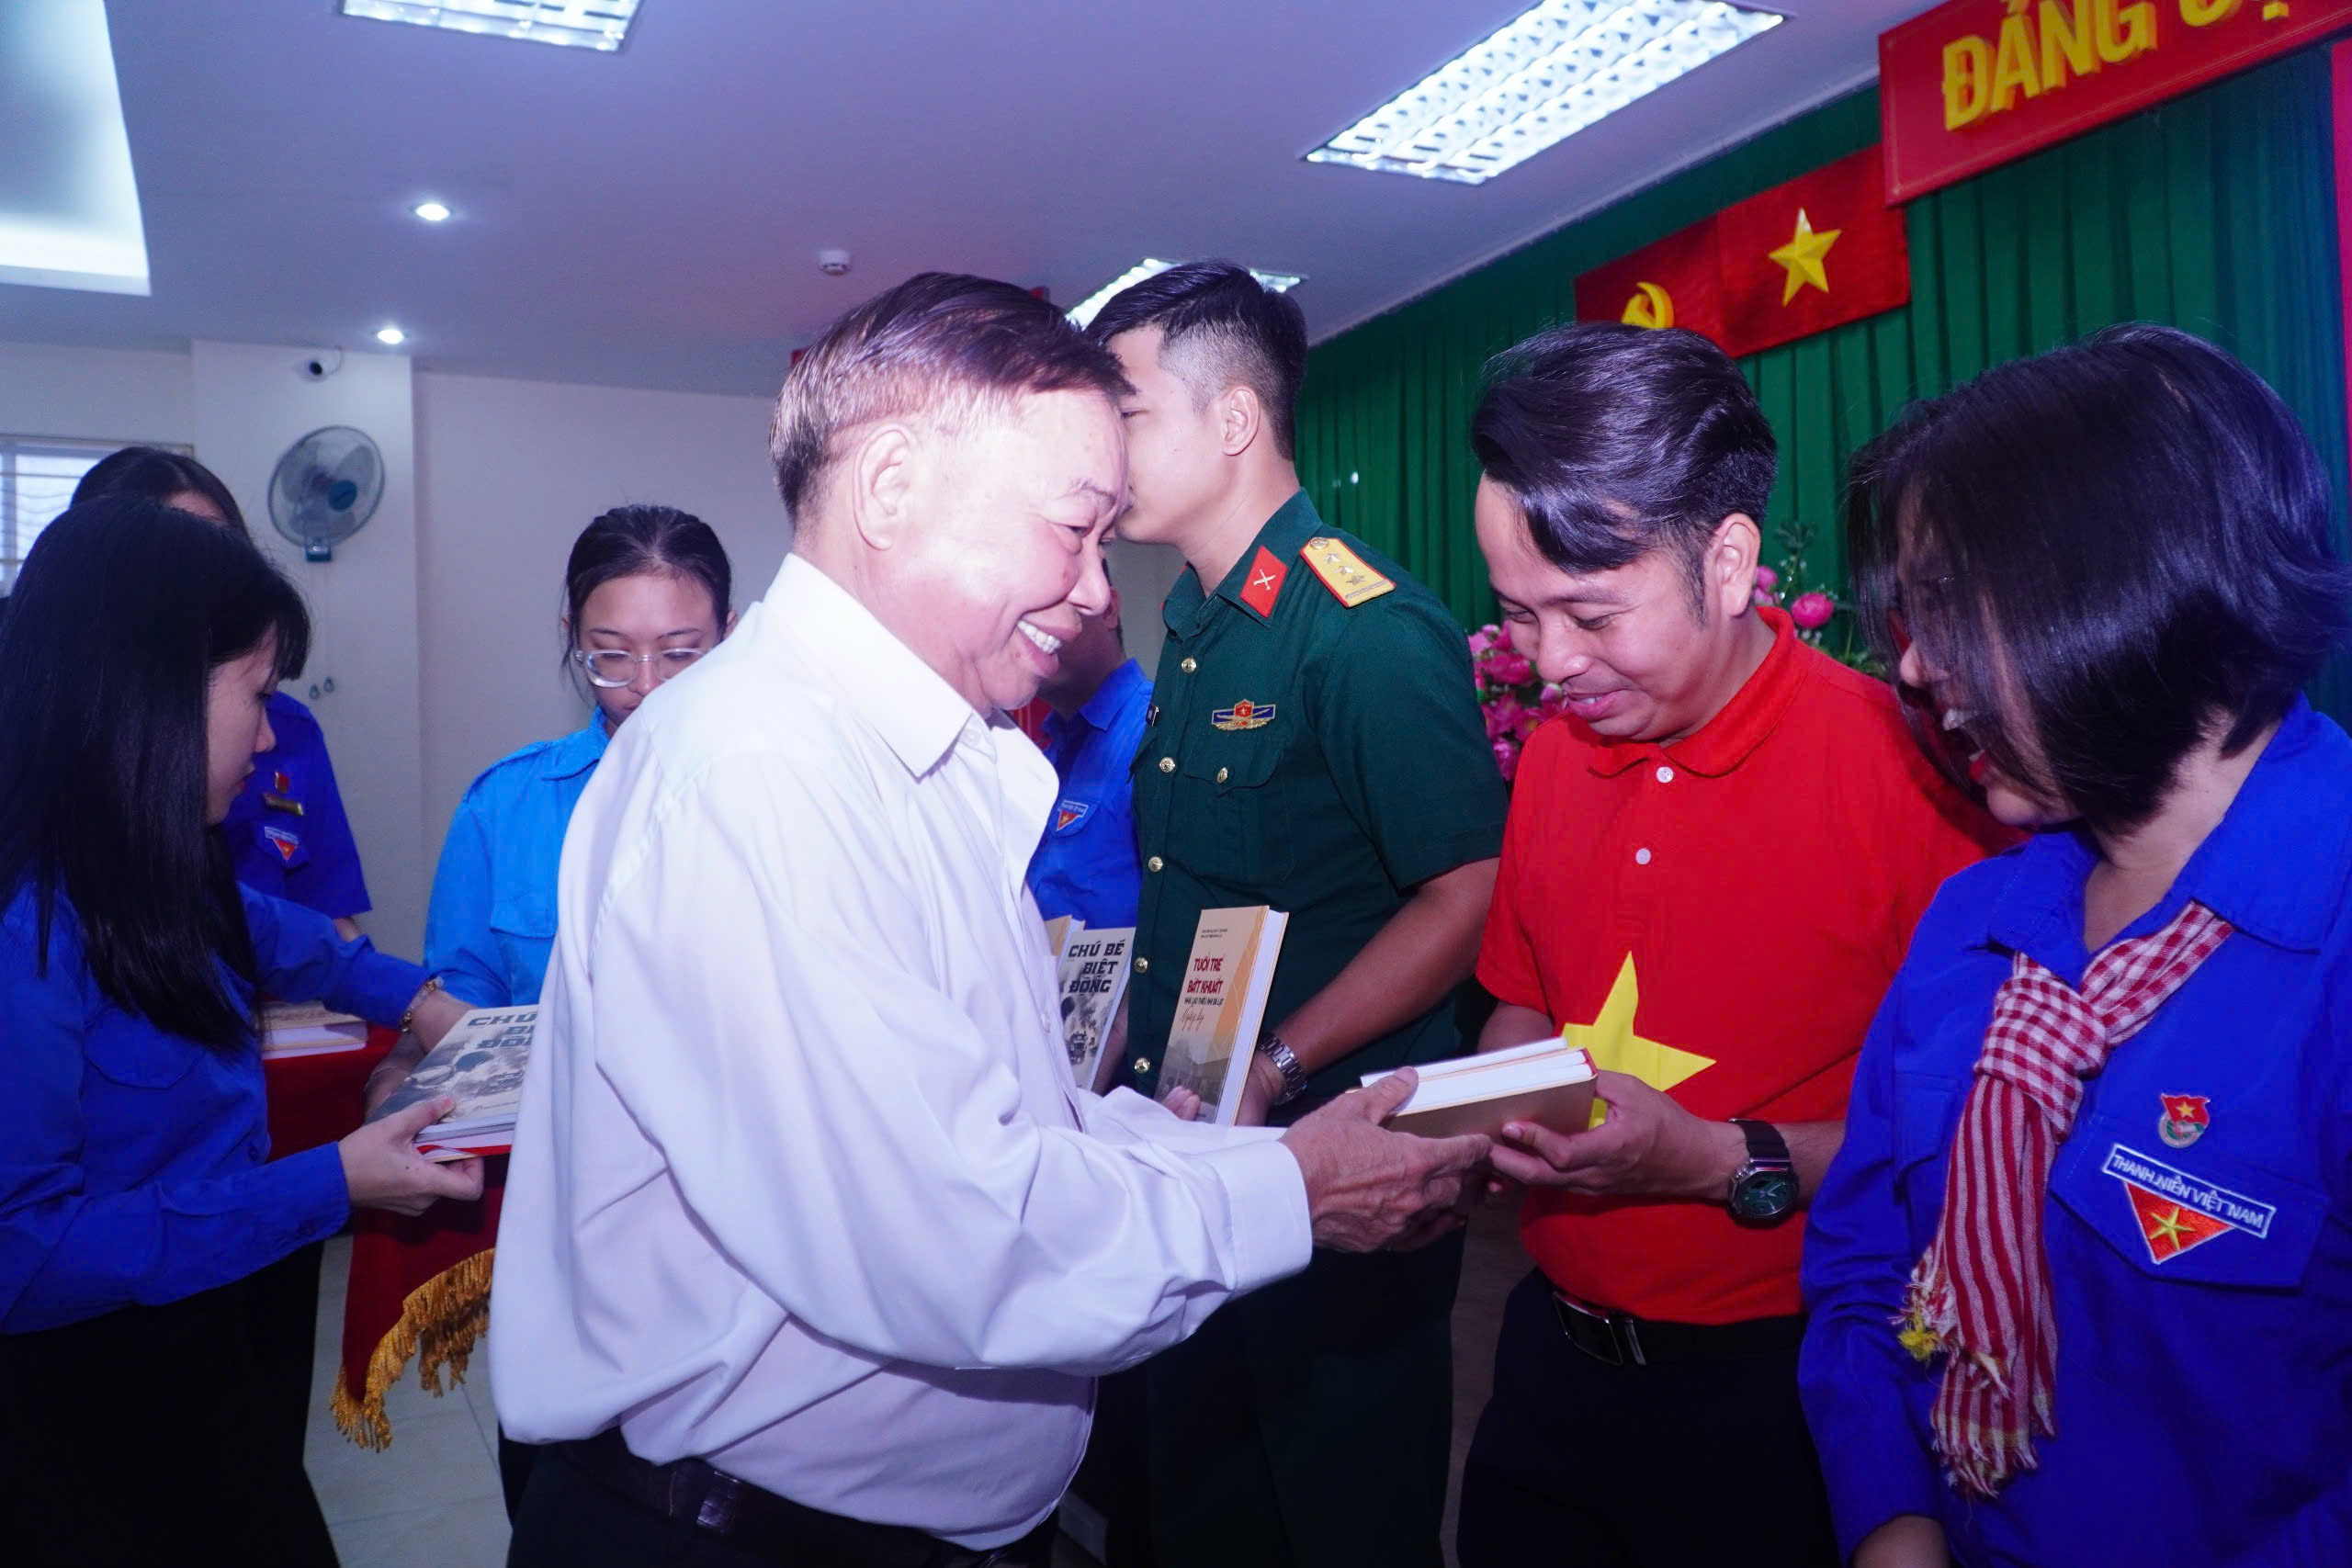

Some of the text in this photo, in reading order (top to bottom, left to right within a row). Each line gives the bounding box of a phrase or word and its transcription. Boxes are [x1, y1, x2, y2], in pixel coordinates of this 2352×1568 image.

[1942, 0, 2155, 130] ĐẢNG
[1069, 939, 1126, 958] CHÚ BÉ
[1081, 958, 1119, 978] BIỆT
[1069, 976, 1113, 997] ĐỘNG
[2113, 1154, 2266, 1229] THANH NIÊN VIỆT NAM
